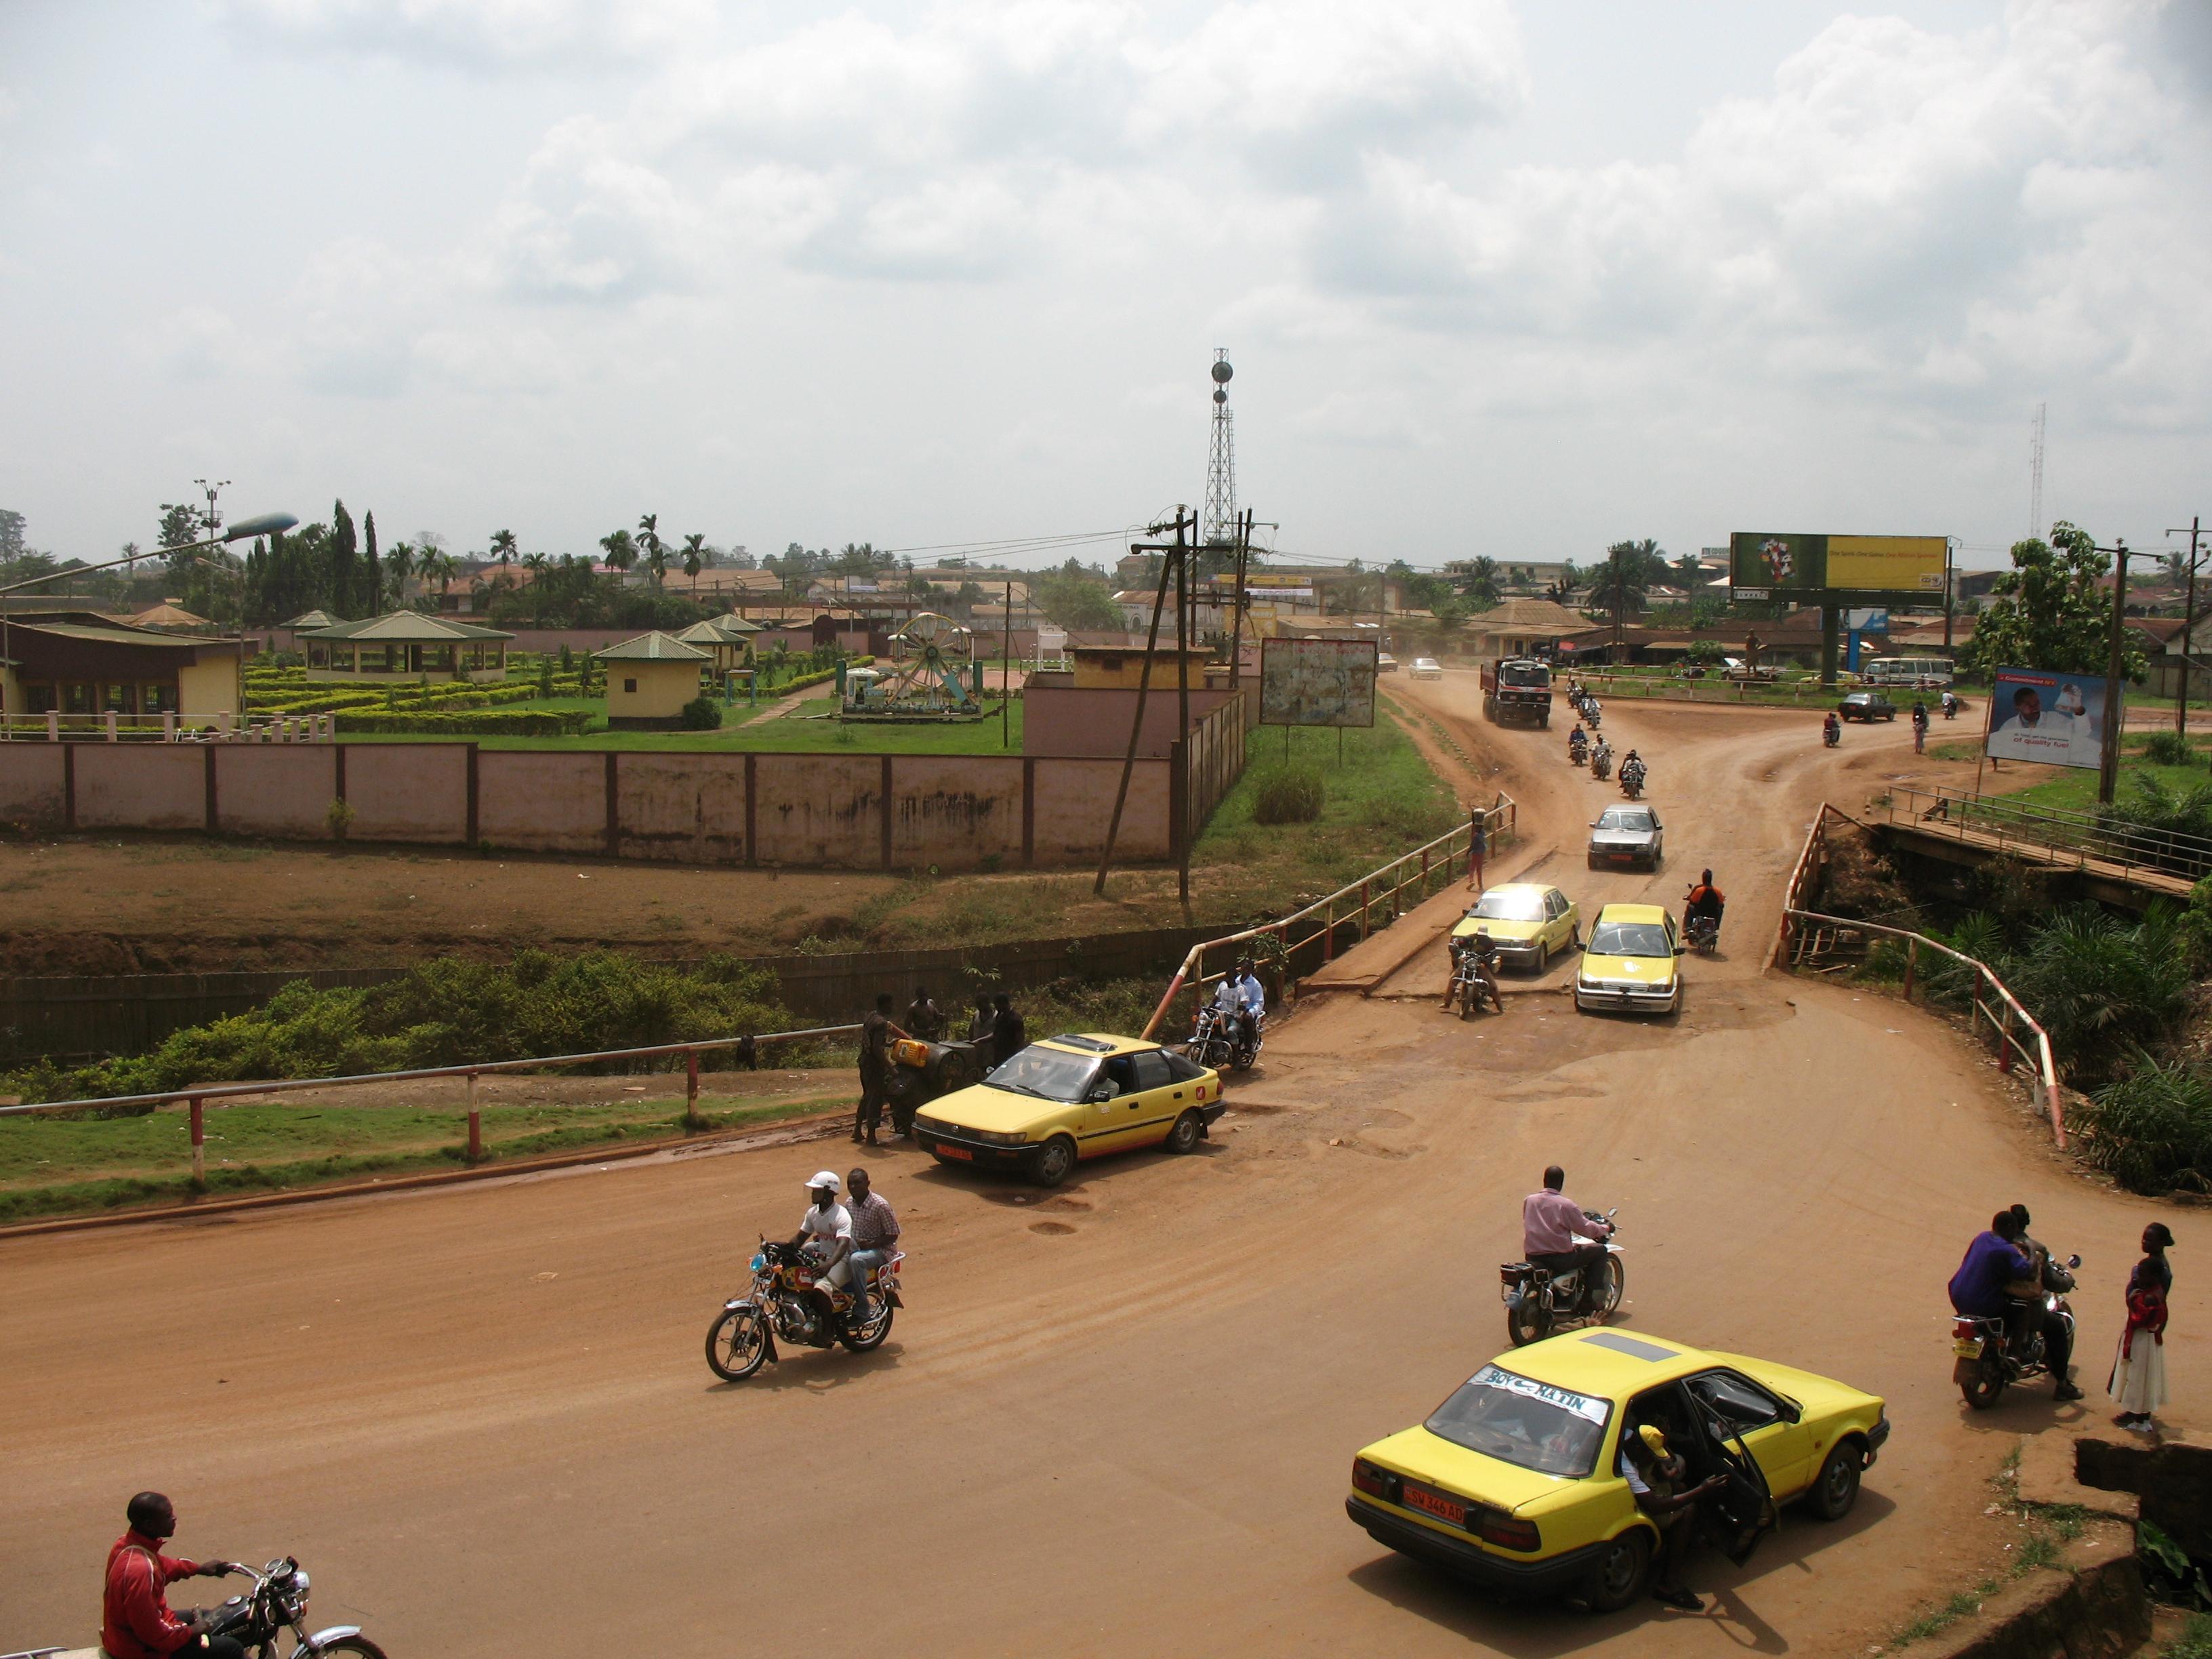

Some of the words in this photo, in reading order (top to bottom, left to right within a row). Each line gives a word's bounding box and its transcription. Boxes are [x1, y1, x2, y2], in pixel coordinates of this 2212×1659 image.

[2024, 738, 2051, 747] quality
[2053, 741, 2070, 749] fuel
[1484, 1370, 1515, 1385] BOY
[1534, 1384, 1586, 1410] MATIN
[1412, 1490, 1425, 1504] SW
[1427, 1496, 1446, 1515] 346
[1448, 1504, 1464, 1521] AD
